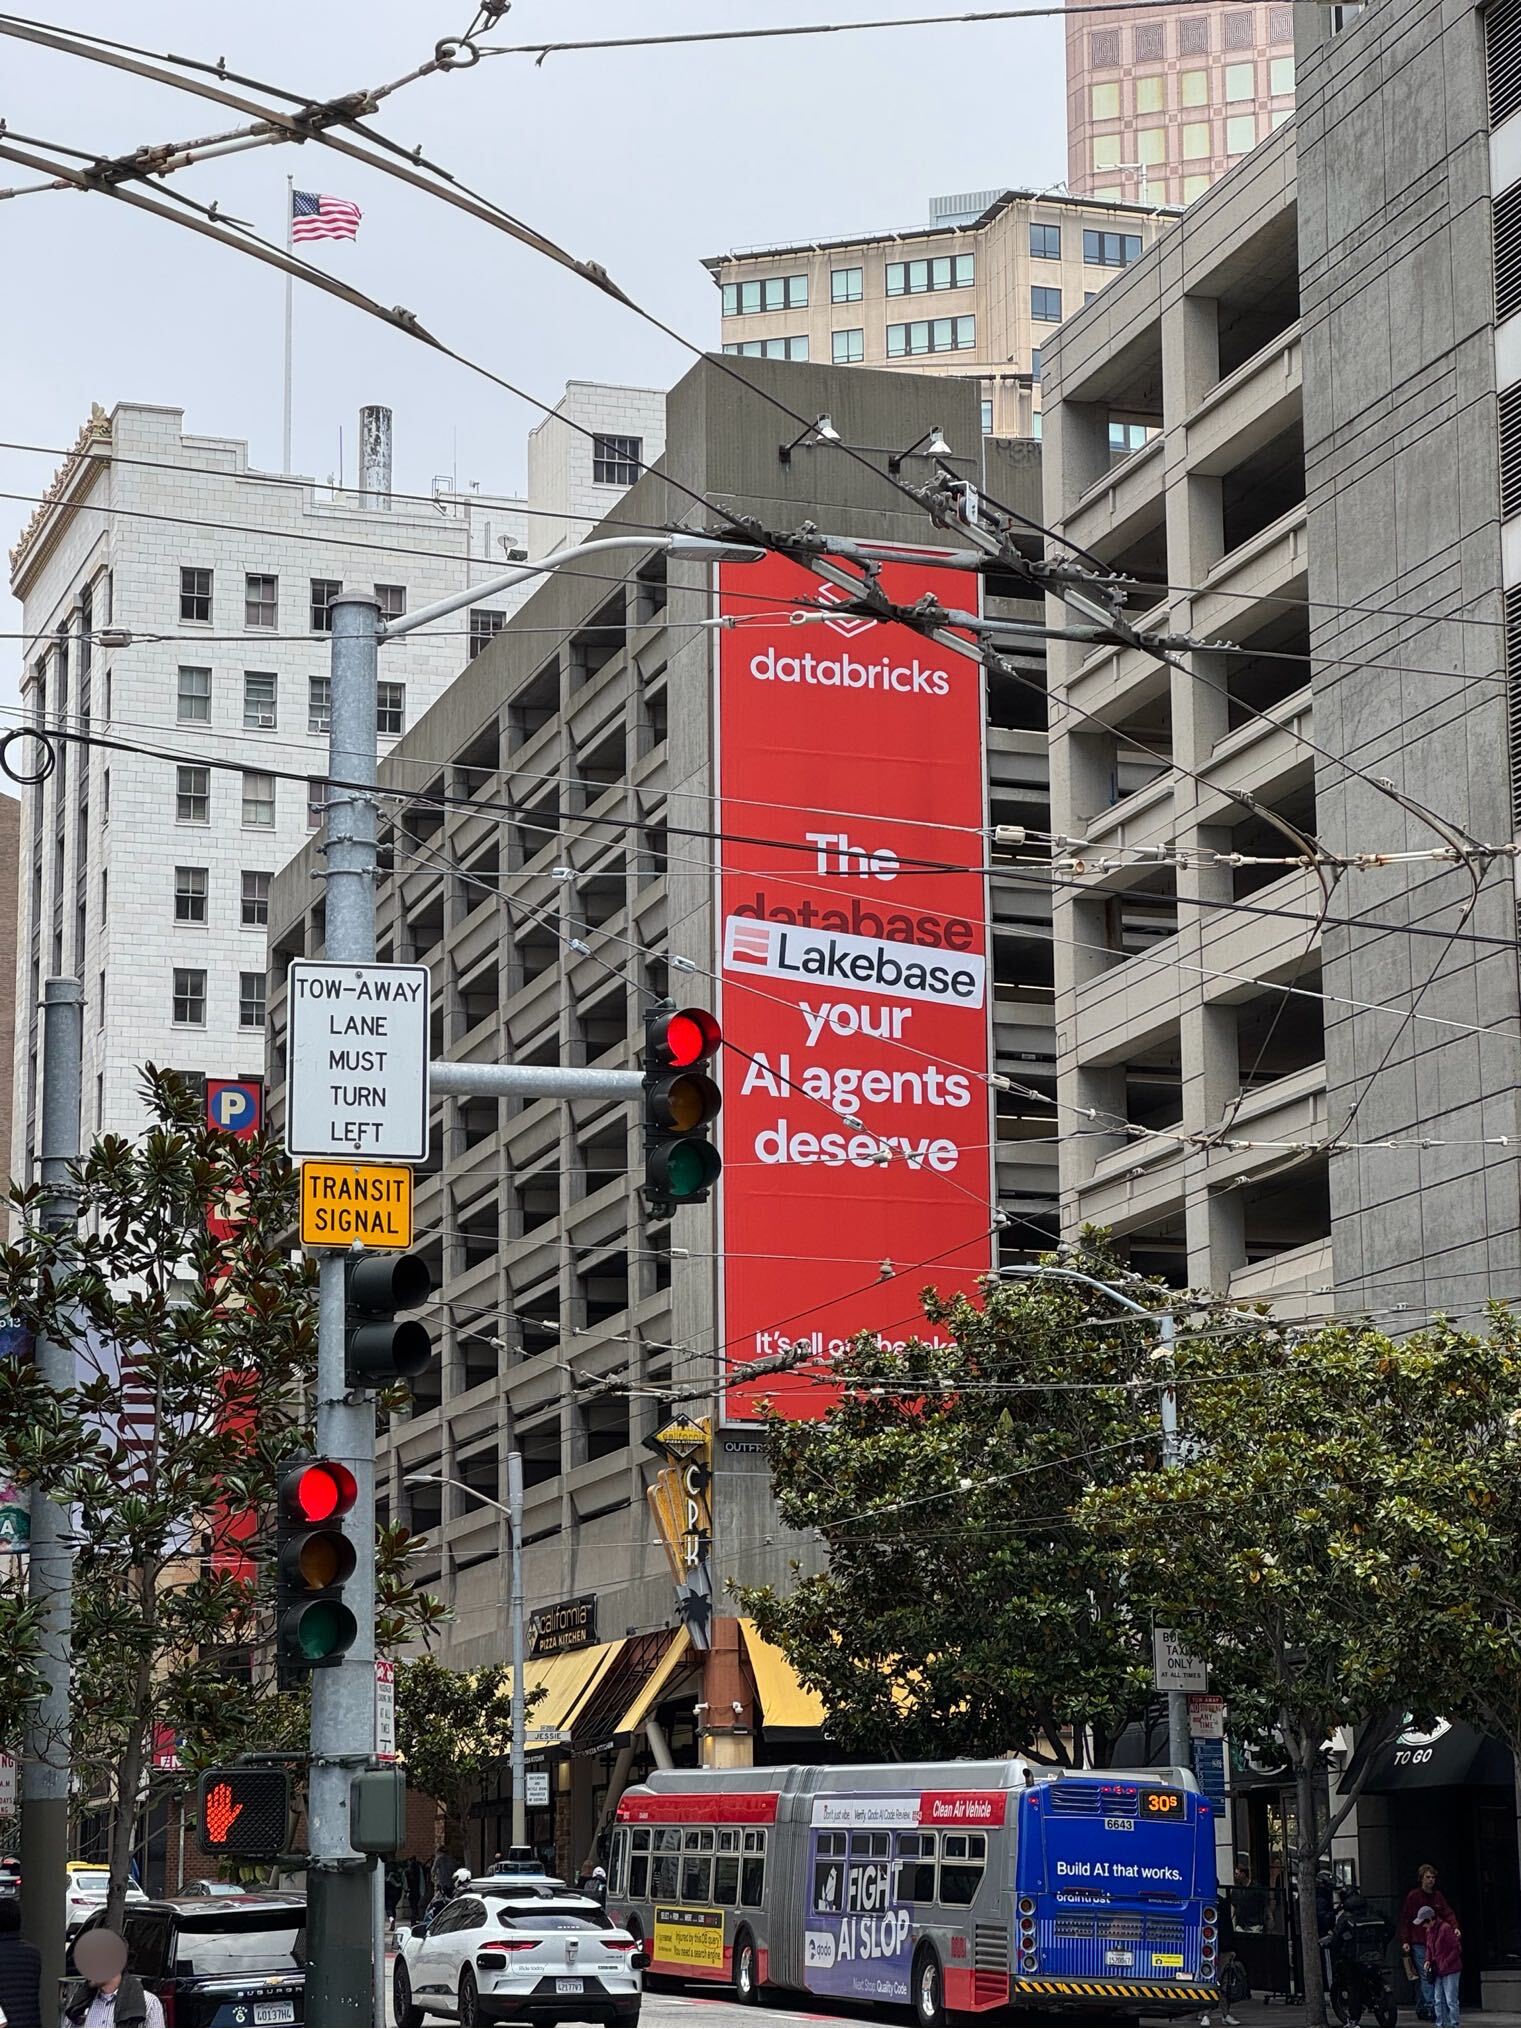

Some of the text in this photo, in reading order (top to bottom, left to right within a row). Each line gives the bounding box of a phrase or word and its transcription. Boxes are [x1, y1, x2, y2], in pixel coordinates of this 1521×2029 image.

[750, 647, 950, 696] databricks
[805, 832, 900, 880] The
[778, 932, 976, 998] Lakebase
[297, 978, 422, 1002] TOW-AWAY
[330, 1015, 388, 1036] LANE
[800, 1000, 912, 1046] your
[330, 1050, 388, 1072] MUST
[741, 1052, 971, 1115] AI agents
[330, 1085, 386, 1107] TURN
[220, 1092, 246, 1124] P
[331, 1122, 384, 1142] LEFT
[755, 1119, 958, 1172] deserve
[309, 1176, 404, 1202] TRANSIT
[315, 1208, 399, 1234] SIGNAL
[756, 1330, 790, 1355] It's
[796, 1332, 823, 1356] ll
[725, 1442, 765, 1452] OUTFR
[540, 1602, 587, 1634] california
[540, 1629, 586, 1650] PIZZA KITCHEN
[1168, 1659, 1192, 1669] ONLY
[1394, 1748, 1432, 1765] TO GO
[884, 1810, 895, 1820] Code
[933, 1800, 992, 1818] Clean Air Vehicle
[1107, 1820, 1132, 1830] 6643
[1057, 1861, 1182, 1881] Build AI that works.
[848, 1862, 904, 1911] FIGHT
[837, 1910, 910, 1962] AI SLOP
[817, 1940, 831, 1959] qodo
[238, 1987, 303, 1997] SUBURBA
[876, 1980, 893, 1996] Quality
[894, 1981, 907, 1995] Code
